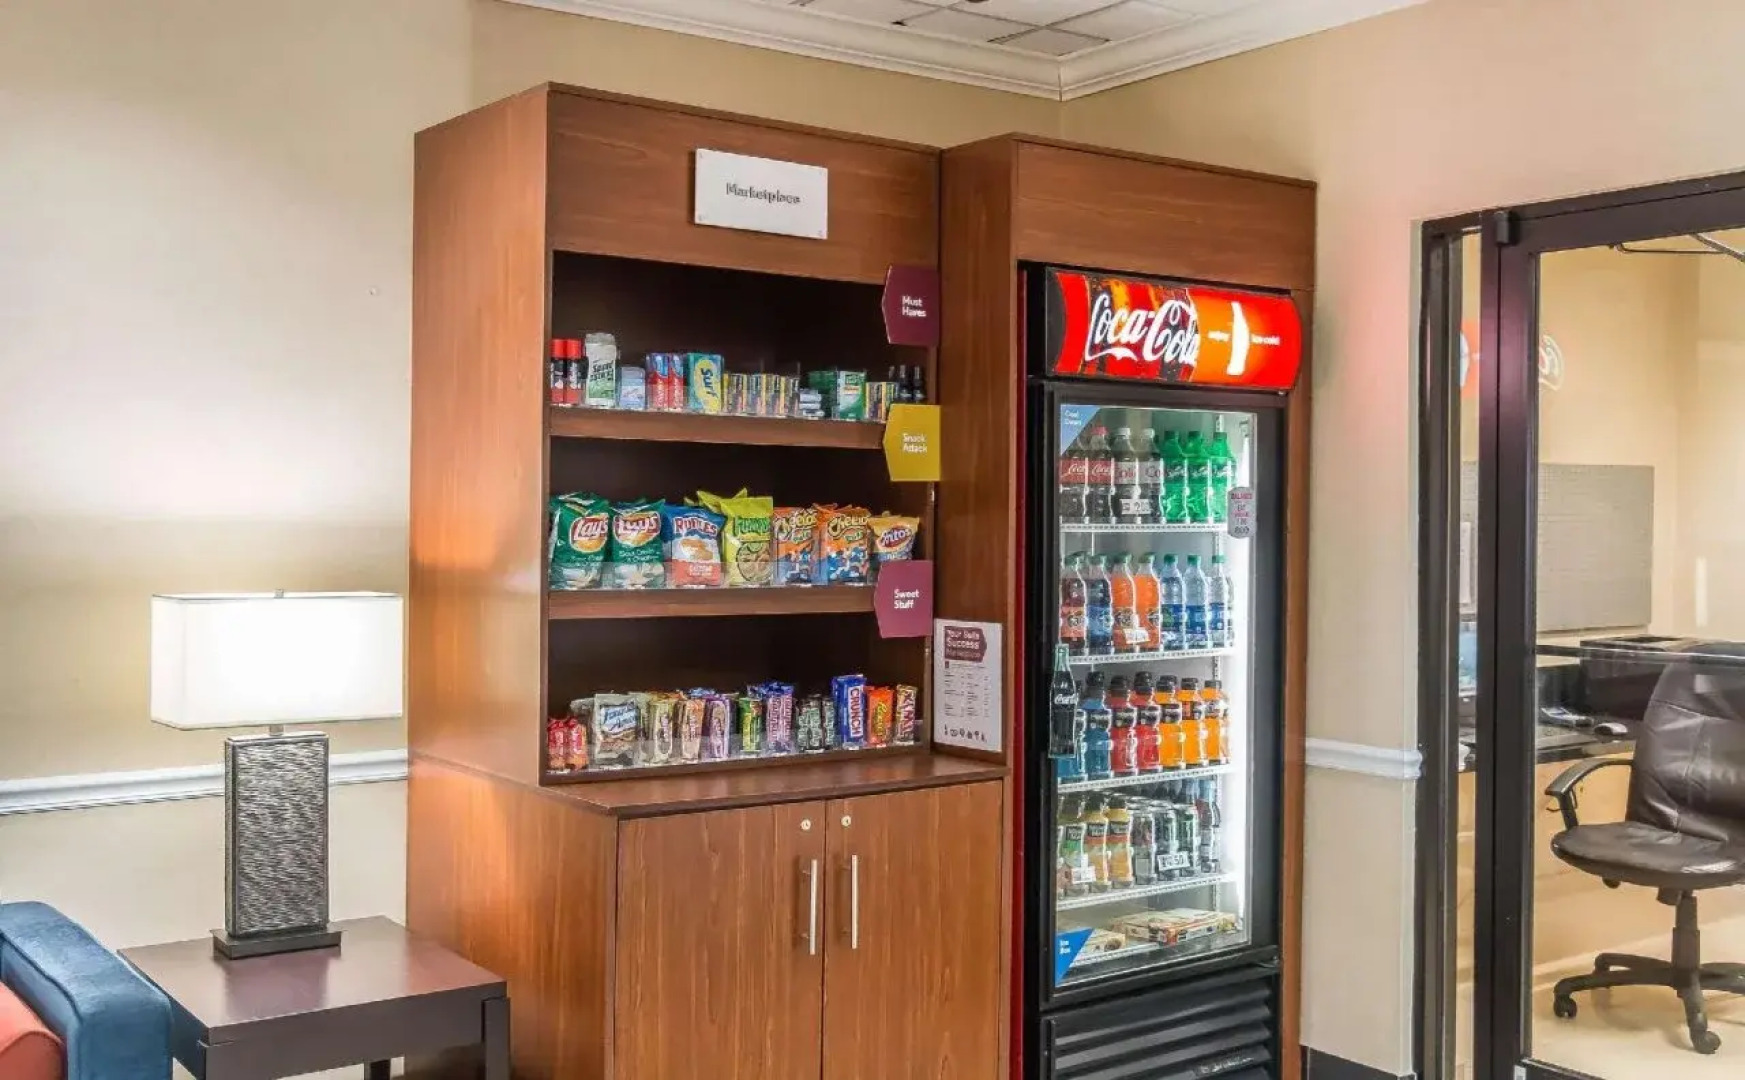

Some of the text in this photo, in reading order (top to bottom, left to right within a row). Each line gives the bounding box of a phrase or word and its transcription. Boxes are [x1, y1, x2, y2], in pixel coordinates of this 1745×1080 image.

[726, 182, 801, 204] Marketplace
[902, 295, 922, 307] Must
[1085, 292, 1200, 366] Coca-Cola
[573, 517, 608, 541] Lay's
[894, 588, 920, 598] Sweet
[894, 599, 914, 609] Stuff
[850, 687, 862, 737] CRUNCH
